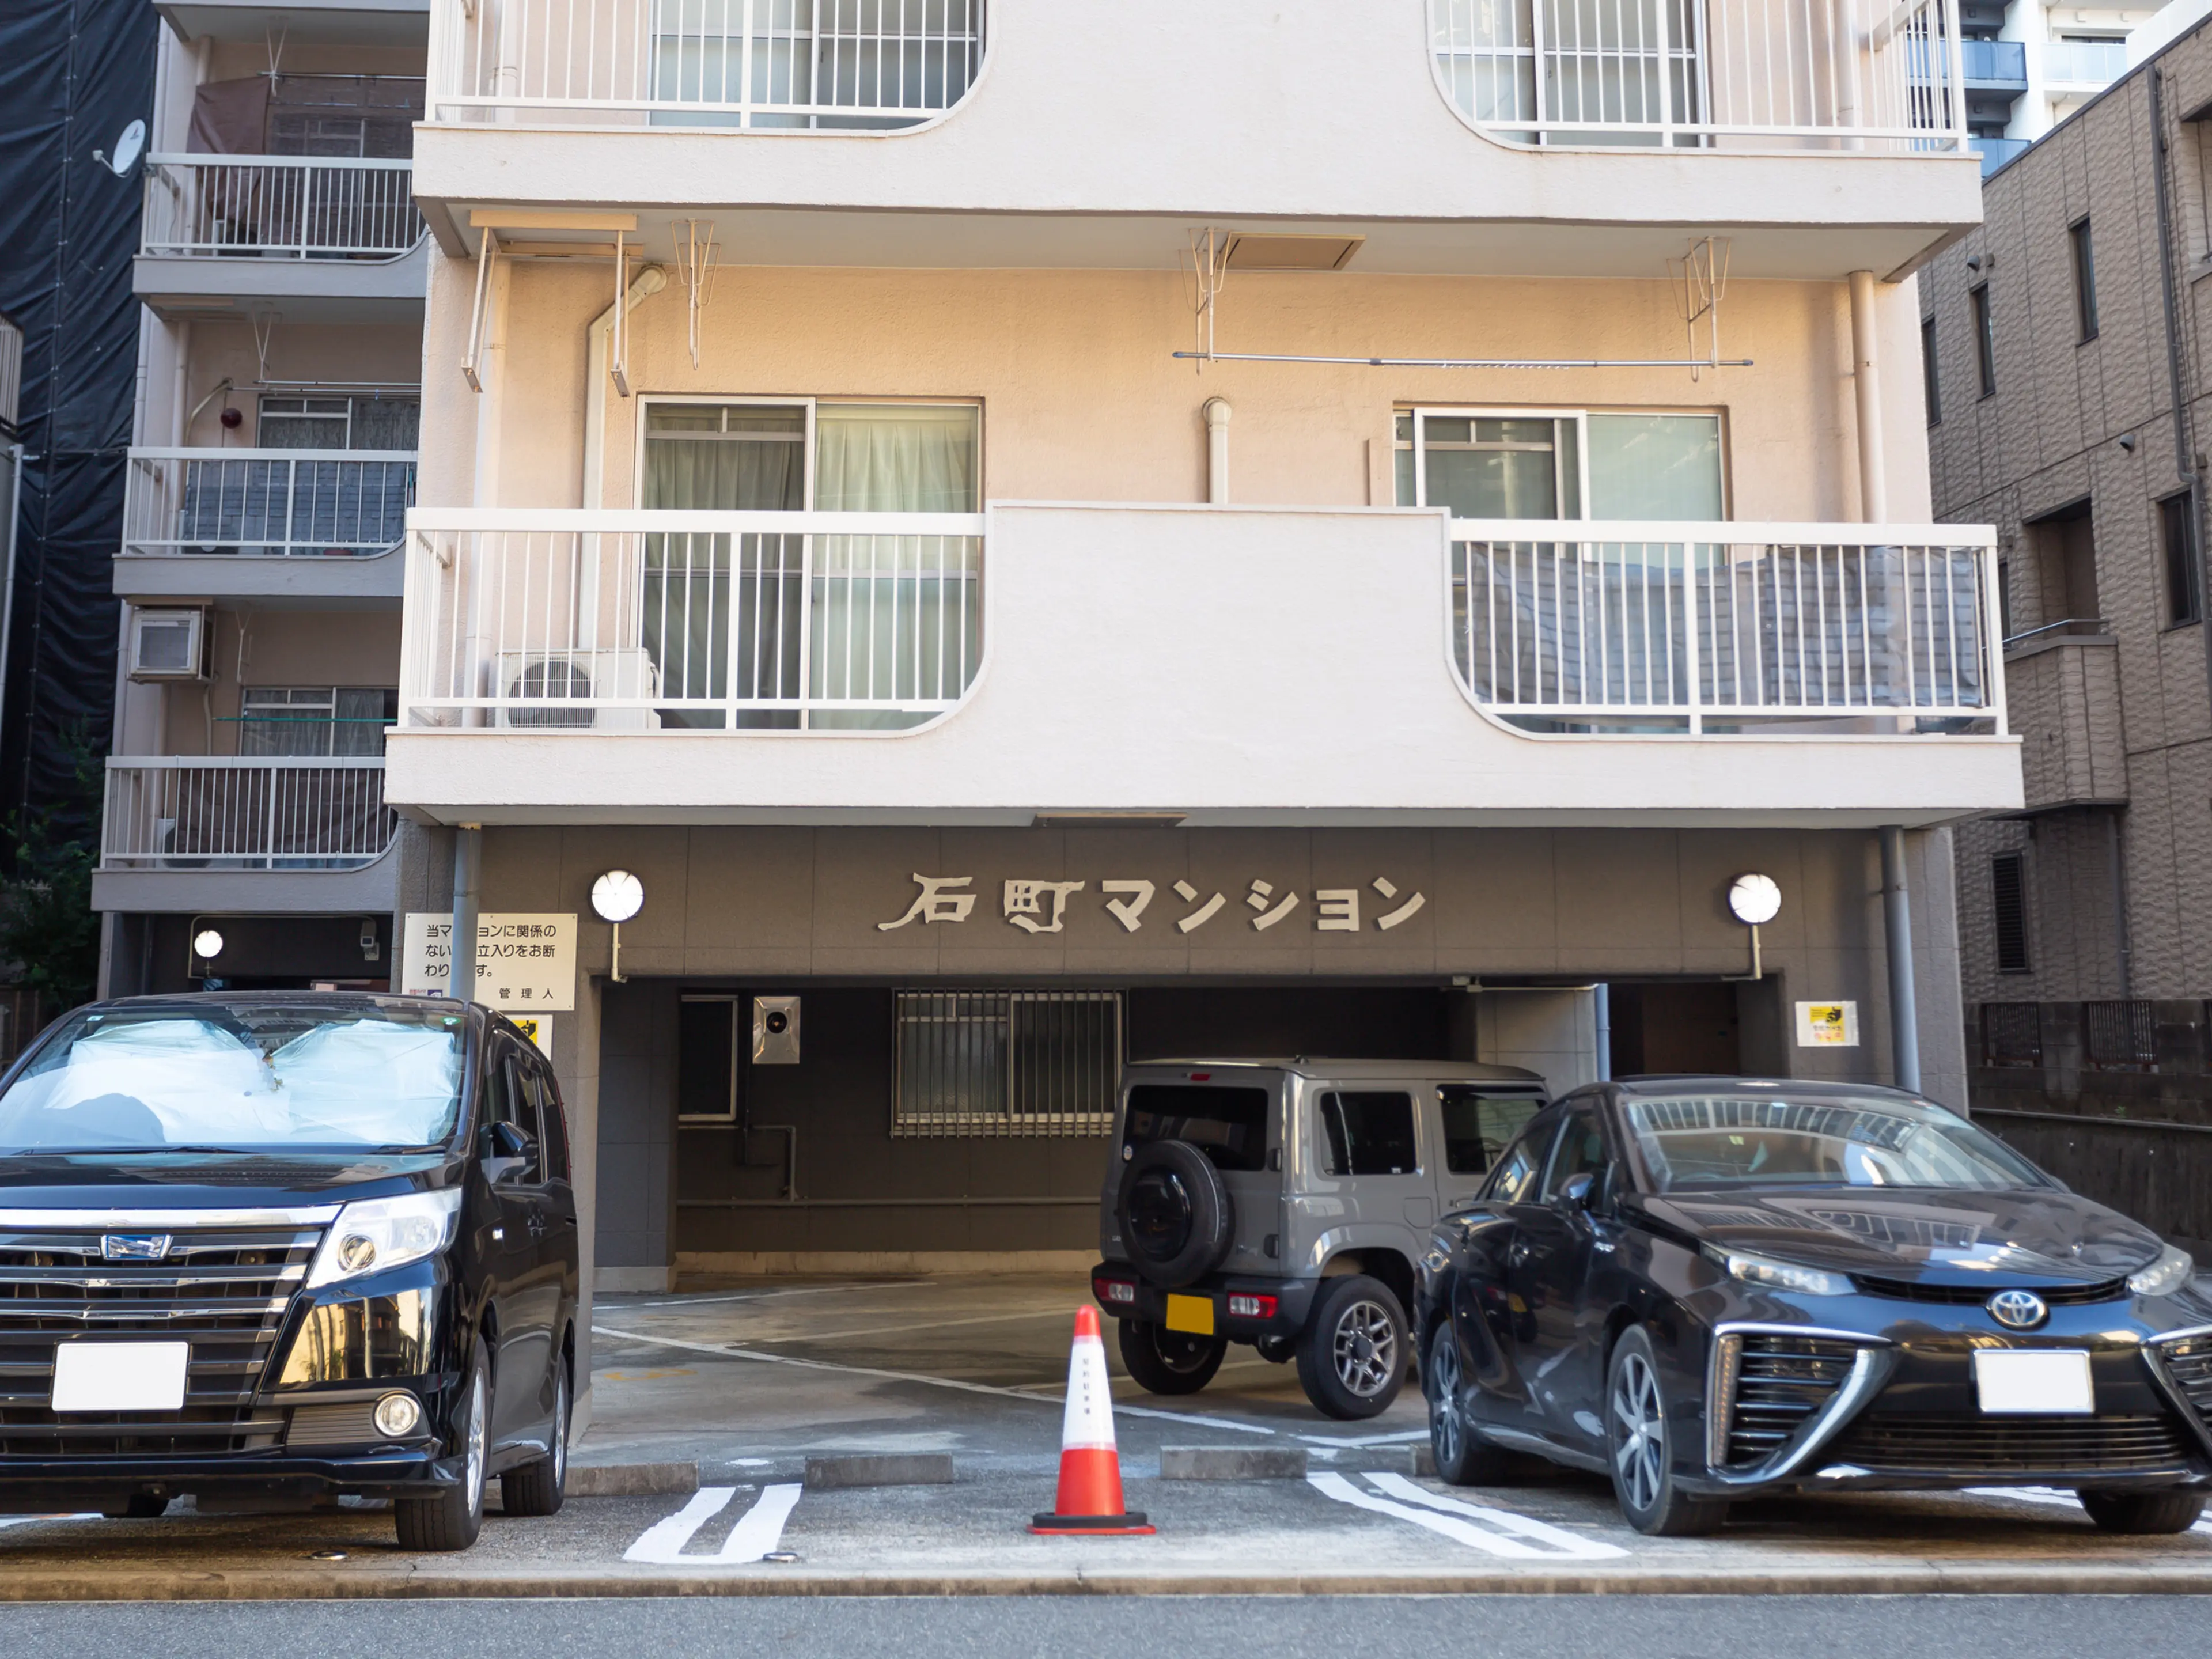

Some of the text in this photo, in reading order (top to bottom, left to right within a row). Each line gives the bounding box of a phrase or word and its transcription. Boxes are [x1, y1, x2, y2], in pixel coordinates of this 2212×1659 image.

[425, 944, 555, 958] ない立入りをお断
[499, 988, 554, 999] 管理人
